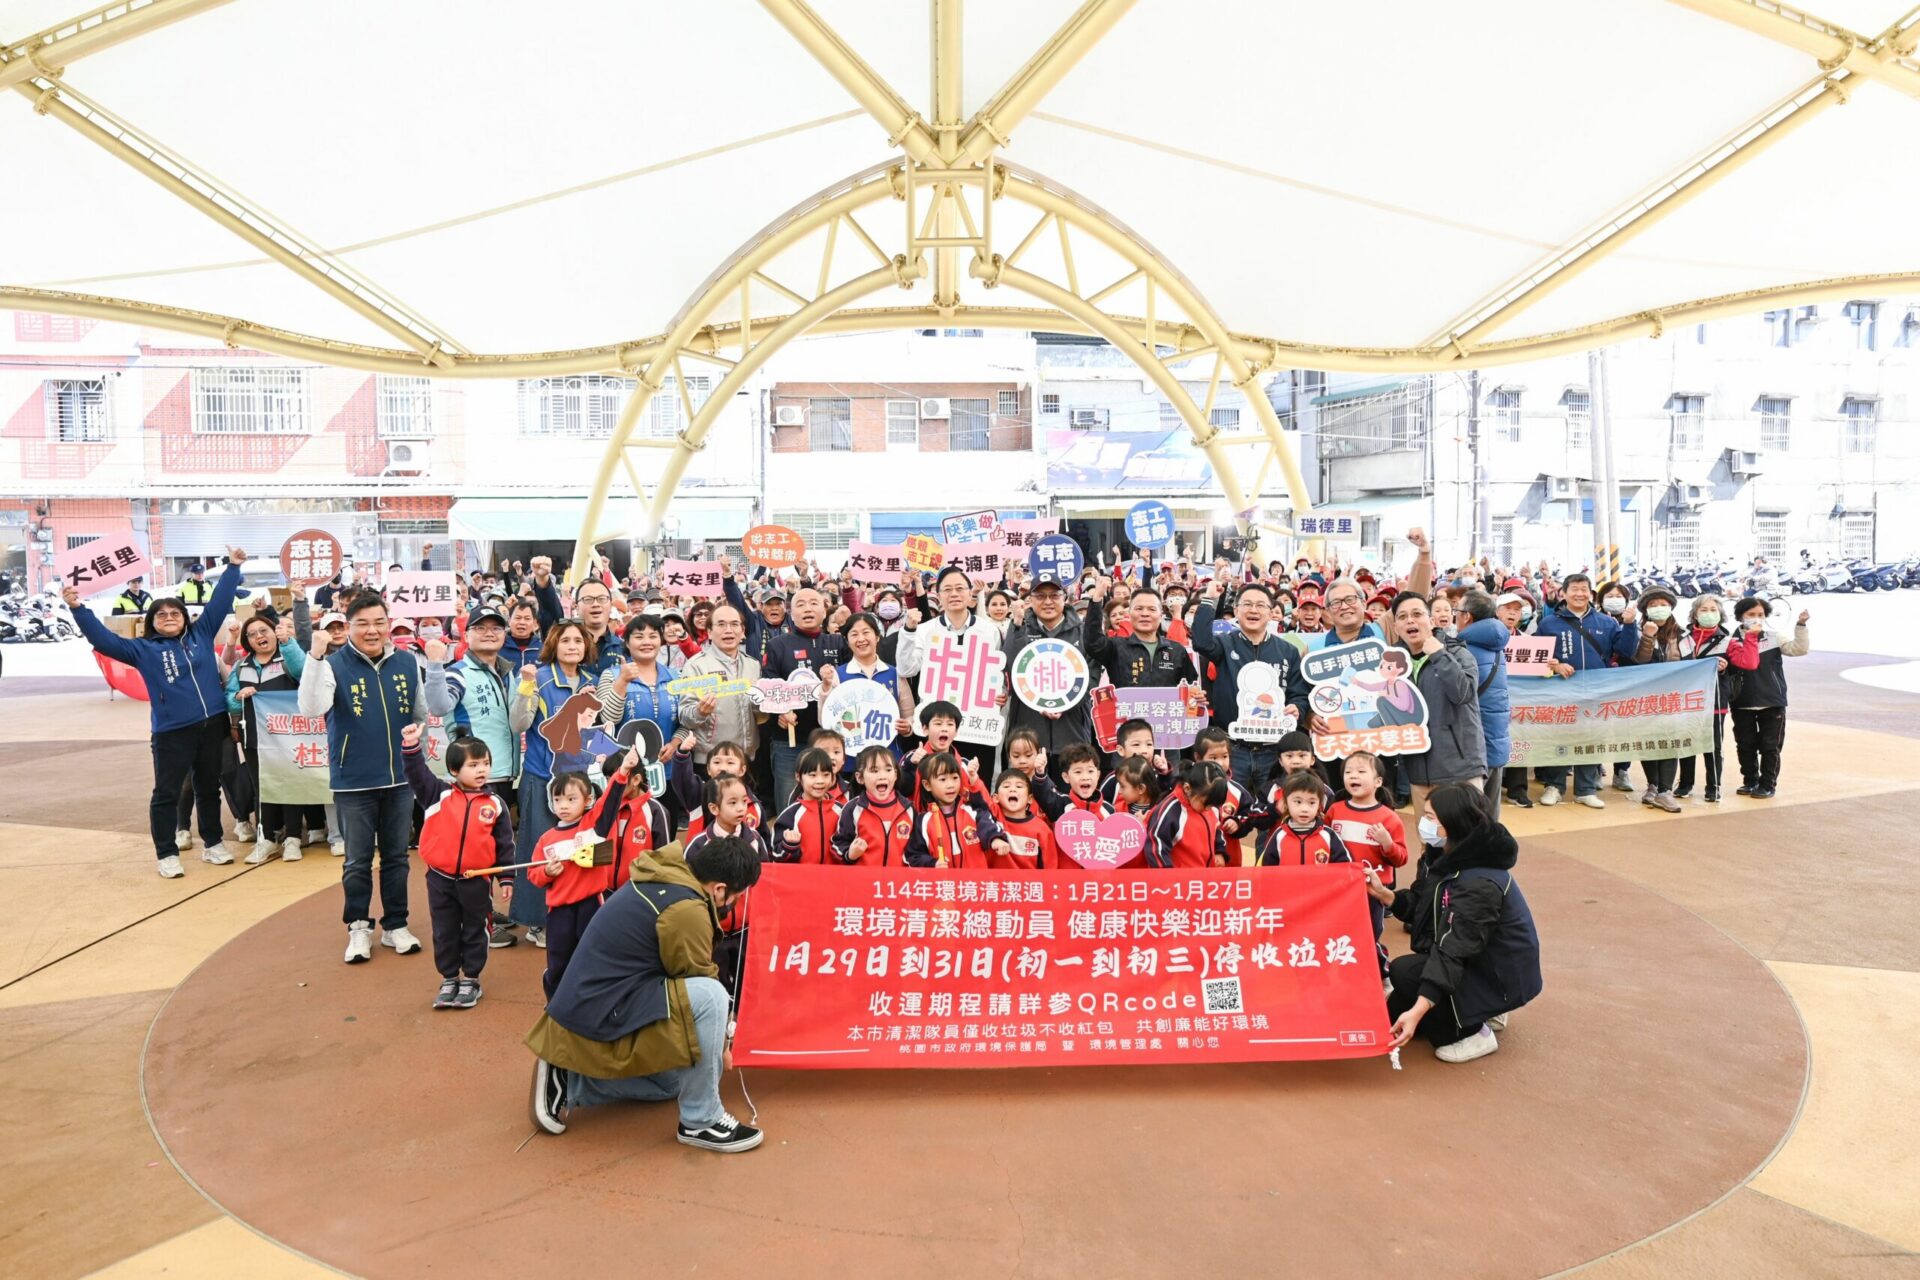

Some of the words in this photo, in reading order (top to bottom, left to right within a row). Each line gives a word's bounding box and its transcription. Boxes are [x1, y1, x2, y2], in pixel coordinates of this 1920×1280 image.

[947, 514, 994, 537] 快樂做
[1132, 507, 1167, 526] 志工
[1300, 517, 1353, 534] 瑞德里
[289, 539, 333, 558] 志在
[1036, 543, 1075, 562] 有志
[66, 545, 141, 587] 大信里
[289, 559, 333, 579] 服務
[851, 554, 901, 572] 大發里
[947, 554, 1000, 573] 大湳里
[1038, 562, 1076, 580] 一同
[668, 572, 721, 587] 大安里
[391, 585, 454, 603] 大竹里
[1116, 701, 1185, 718] 高壓容器
[864, 710, 892, 741] 你
[293, 742, 329, 768] 杜
[1510, 741, 1531, 753] 中心
[1061, 820, 1096, 837] 市長
[832, 906, 1056, 940] 環境清潔總動員
[1067, 906, 1285, 941] 健康快樂迎新年
[768, 935, 1358, 982] 1月29日到31日(初一到初三)停收垃圾
[847, 1021, 1114, 1042] 本市清潔隊員僅收垃圾不收紅包
[1136, 1014, 1270, 1034] 共創廉能好環境
[899, 1040, 1047, 1055] 桃園市政府環境保護局
[1089, 1037, 1163, 1051] 環境管理處
[1176, 1036, 1221, 1049] 關心您
